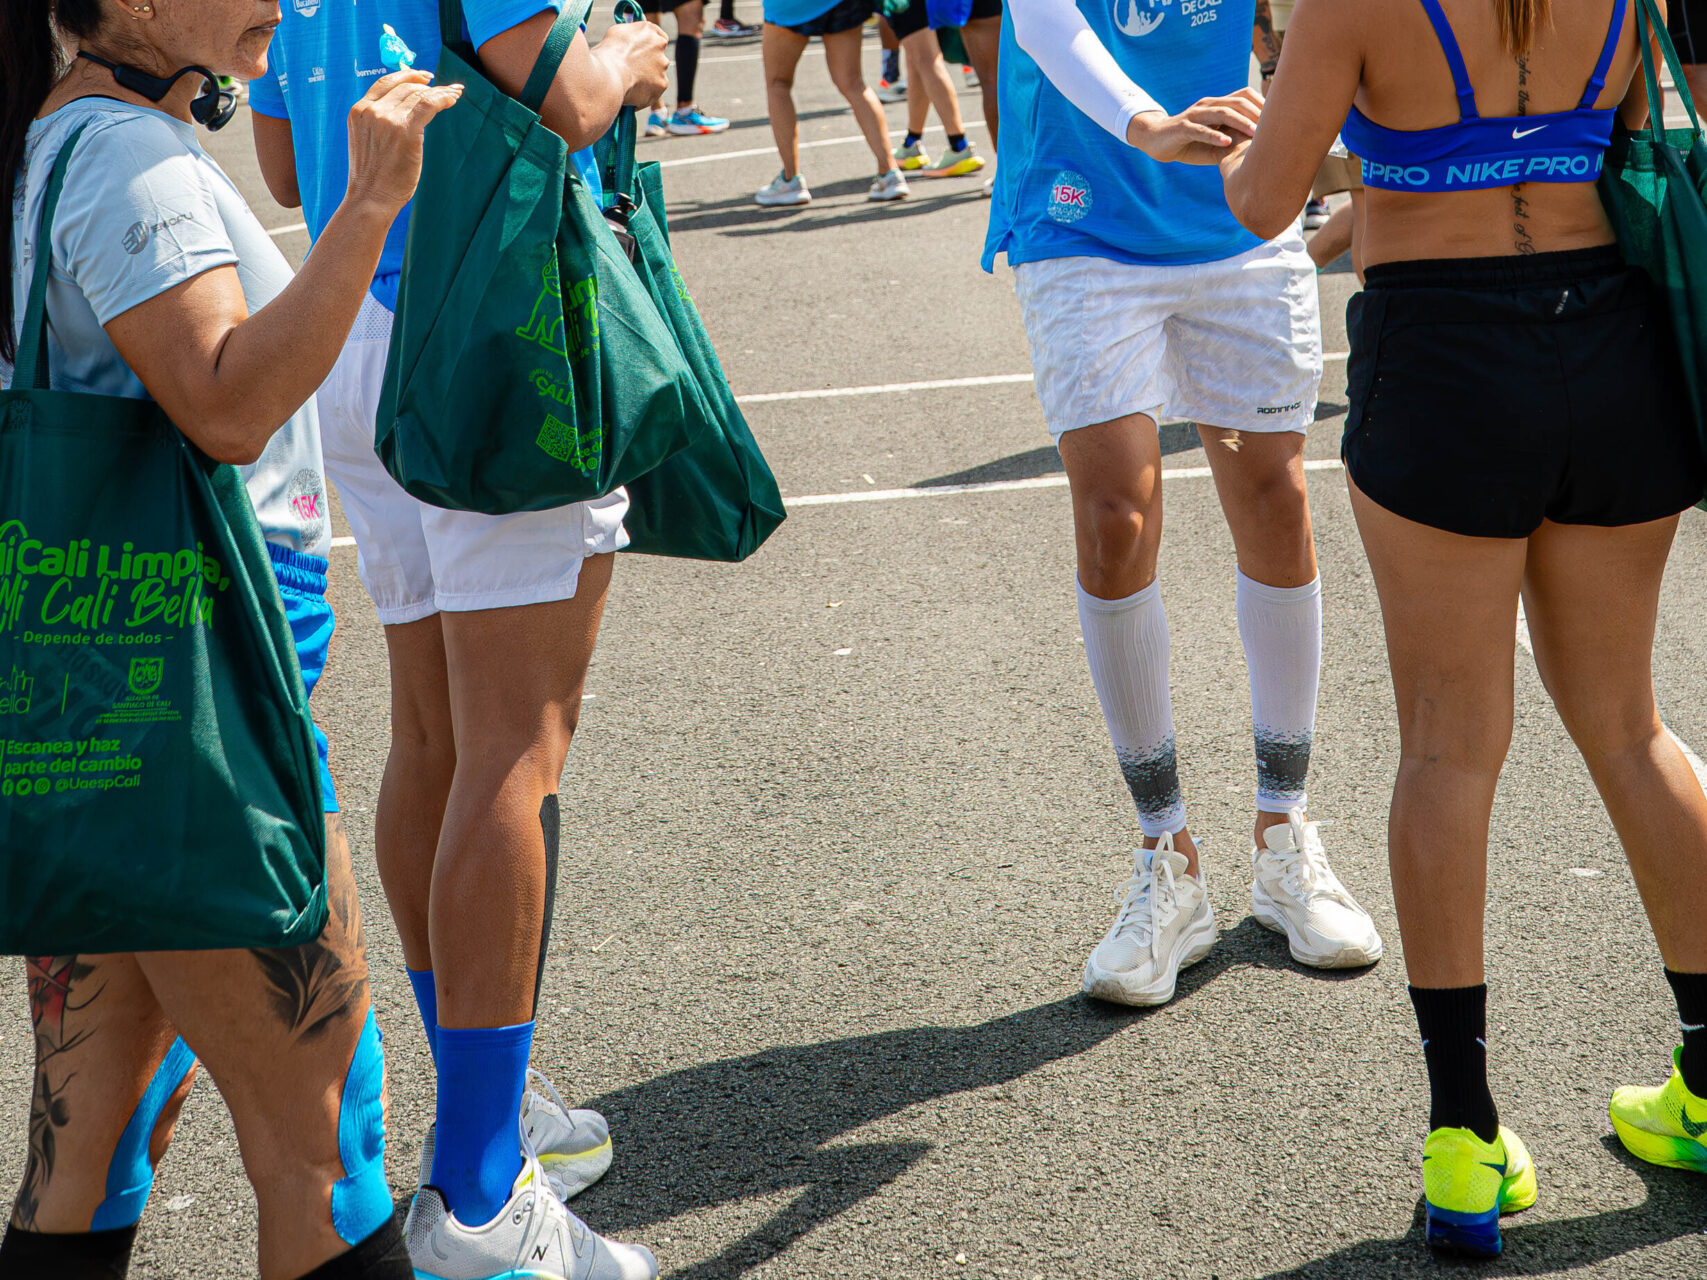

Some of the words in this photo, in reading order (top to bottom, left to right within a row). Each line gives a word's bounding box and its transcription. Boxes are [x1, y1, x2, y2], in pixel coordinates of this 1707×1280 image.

[1181, 0, 1197, 16] DE
[1190, 9, 1218, 28] 2025
[1369, 162, 1430, 186] PRO
[1445, 158, 1524, 185] NIKE
[1525, 155, 1589, 176] PRO
[1053, 185, 1086, 207] 15K
[293, 494, 320, 521] 15K
[41, 572, 119, 630] Cali
[125, 573, 214, 630] Bella
[23, 630, 90, 646] Depende
[95, 631, 114, 645] de
[118, 631, 162, 645] todos
[7, 740, 73, 754] Escanea
[76, 740, 88, 756] y
[90, 737, 121, 753] haz
[5, 759, 47, 778] parte
[50, 757, 77, 773] del
[79, 754, 142, 773] cambio
[56, 773, 141, 793] @UaespCali
